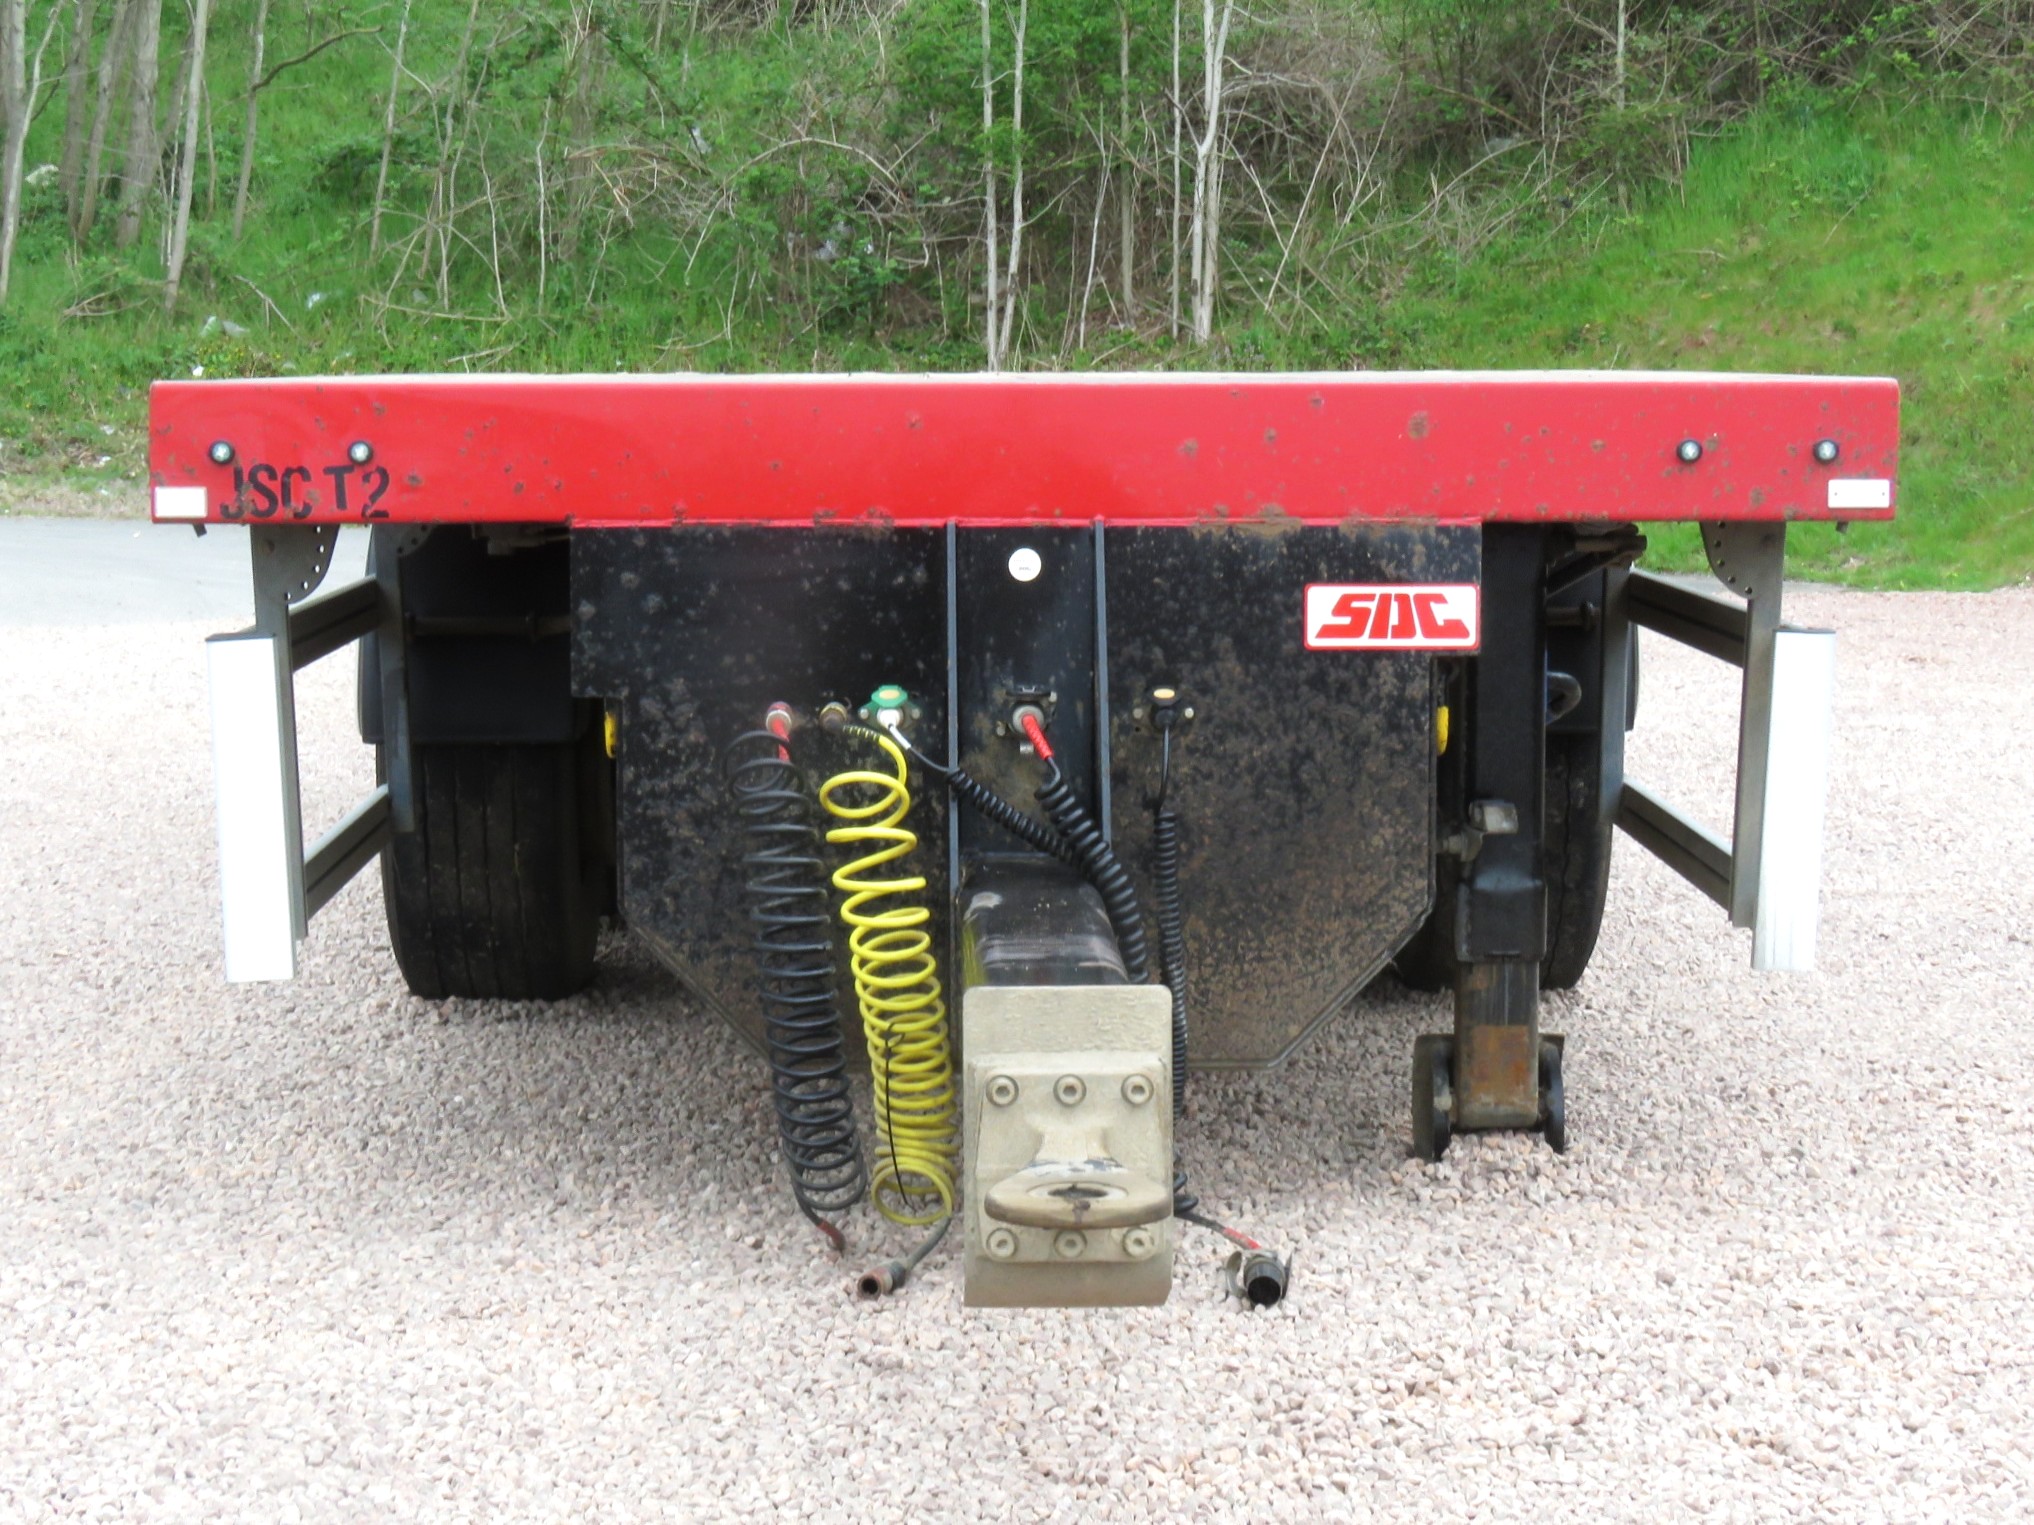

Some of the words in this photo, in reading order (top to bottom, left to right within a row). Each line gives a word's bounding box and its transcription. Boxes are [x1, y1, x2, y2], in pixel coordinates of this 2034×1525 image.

[219, 464, 314, 520] JSC
[323, 465, 390, 520] T2
[1315, 592, 1471, 640] SDC
